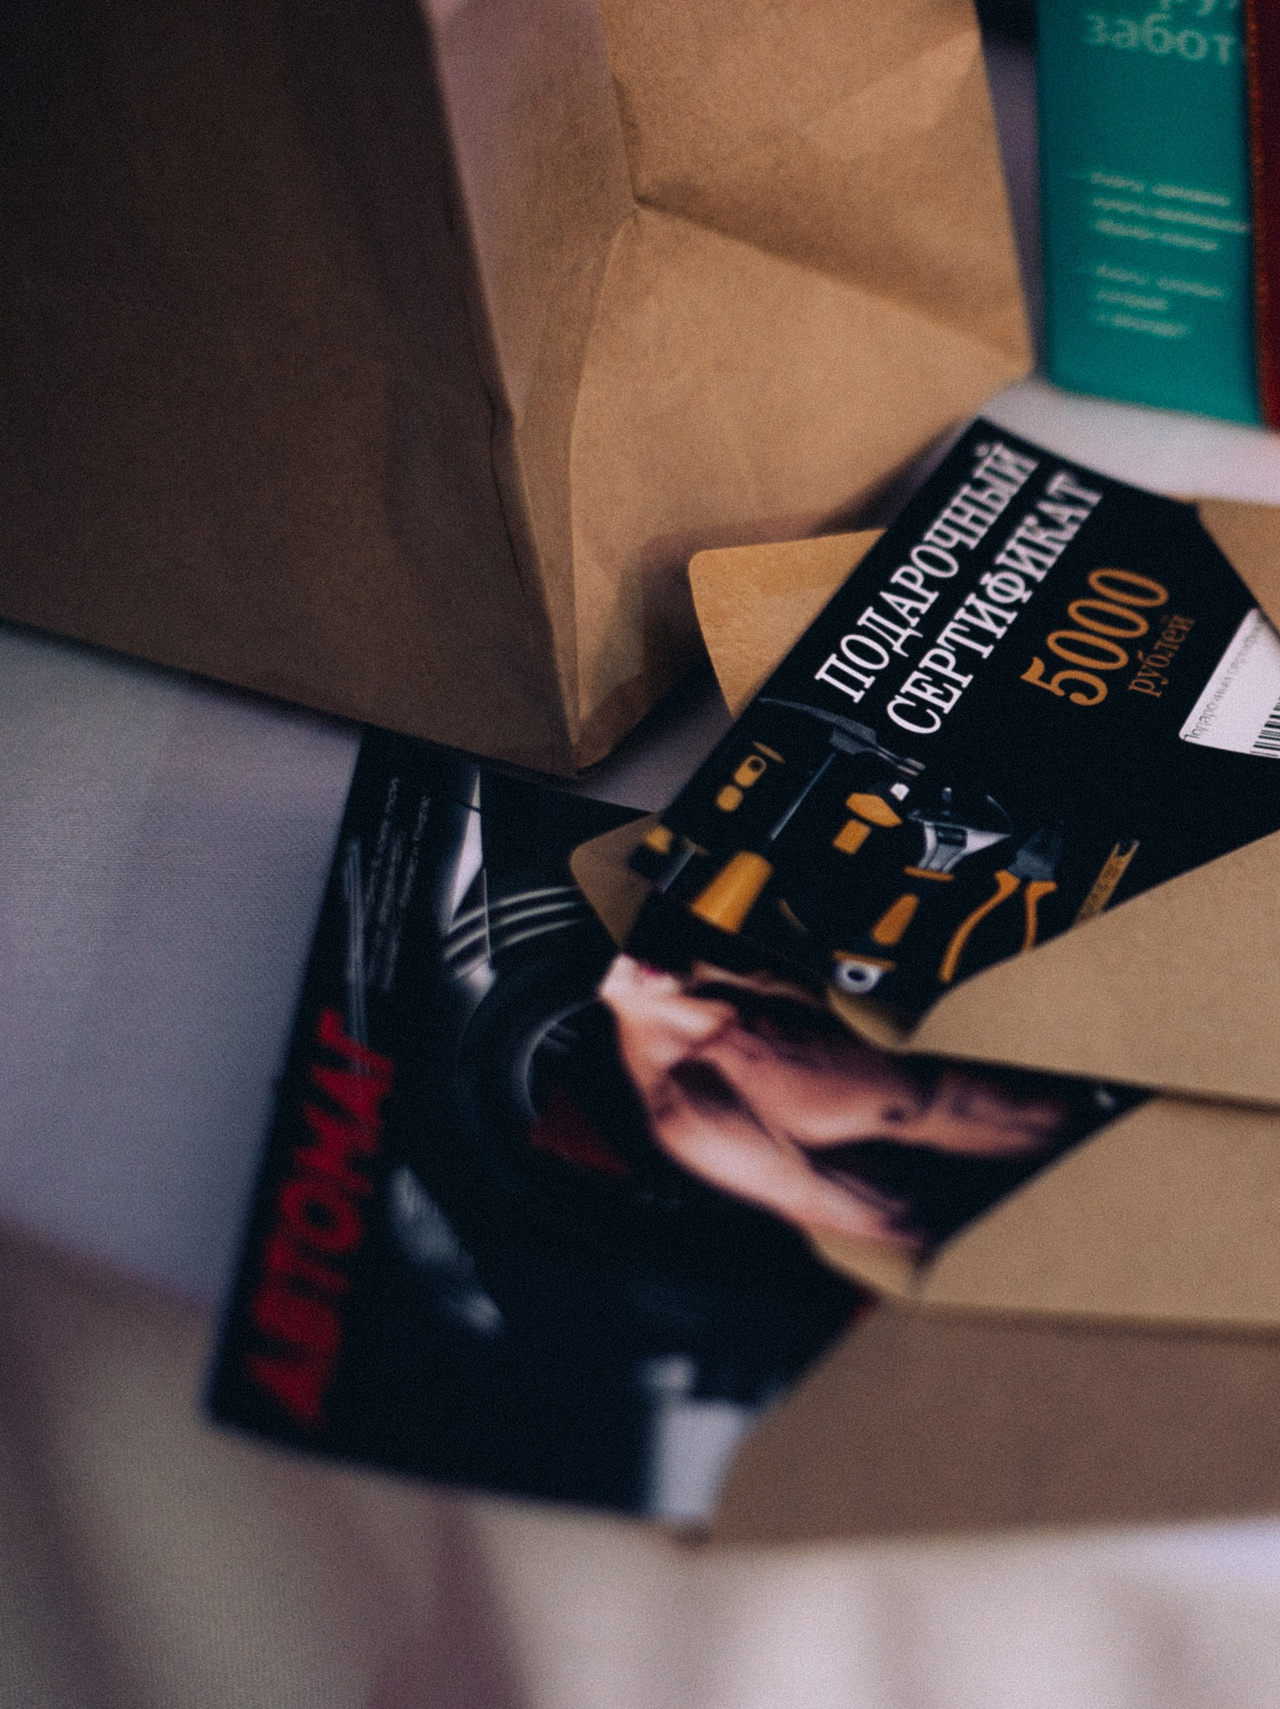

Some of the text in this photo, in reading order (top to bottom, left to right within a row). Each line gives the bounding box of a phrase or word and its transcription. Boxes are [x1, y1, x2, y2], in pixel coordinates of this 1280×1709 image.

[815, 440, 1040, 703] ПОДАРОЧНЫЙ
[887, 471, 1102, 735] СЕРТИФИКАТ
[1021, 567, 1169, 706] 5000
[1128, 614, 1196, 698] рублей
